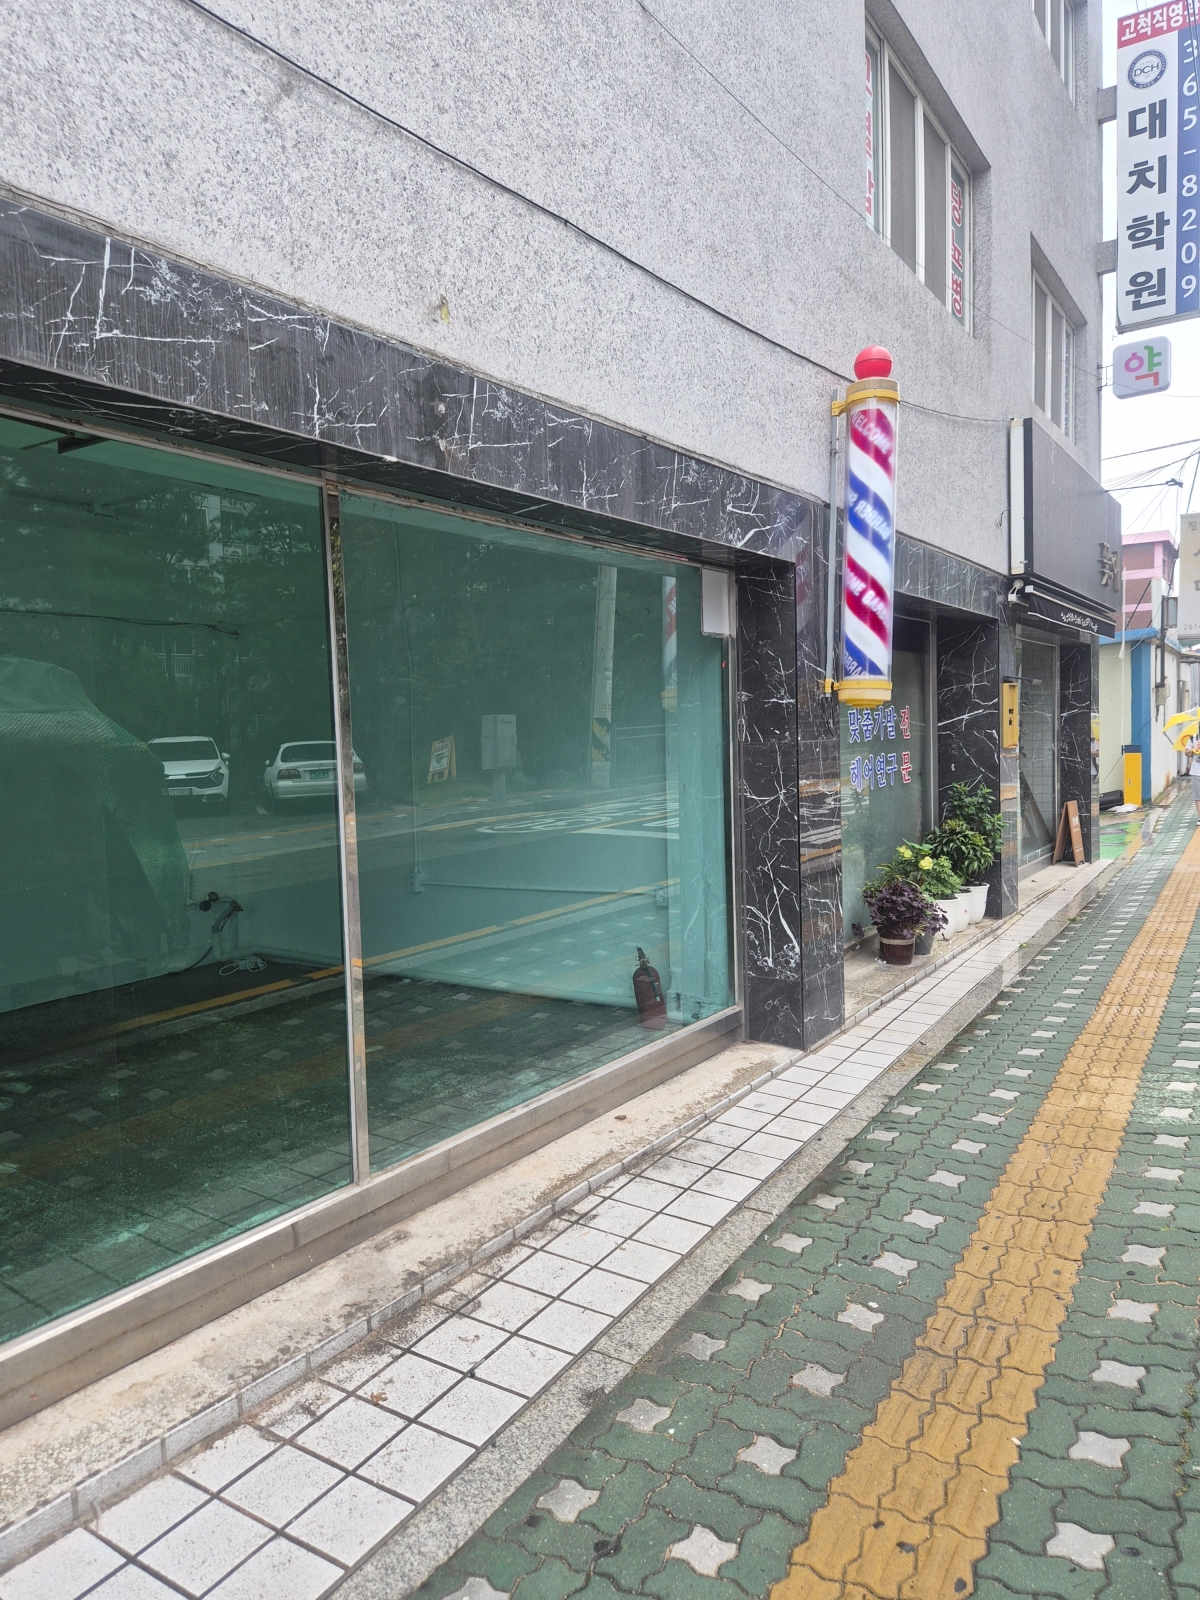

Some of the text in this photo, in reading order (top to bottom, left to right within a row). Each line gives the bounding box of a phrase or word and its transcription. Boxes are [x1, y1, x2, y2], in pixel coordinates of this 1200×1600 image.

[1134, 63, 1160, 77] DCH
[1181, 39, 1198, 298] 365-8209
[1125, 98, 1170, 311] 대치학원
[1123, 345, 1162, 387] 약
[848, 705, 897, 743] 맞춤가발
[849, 752, 898, 792] 헤어연구
